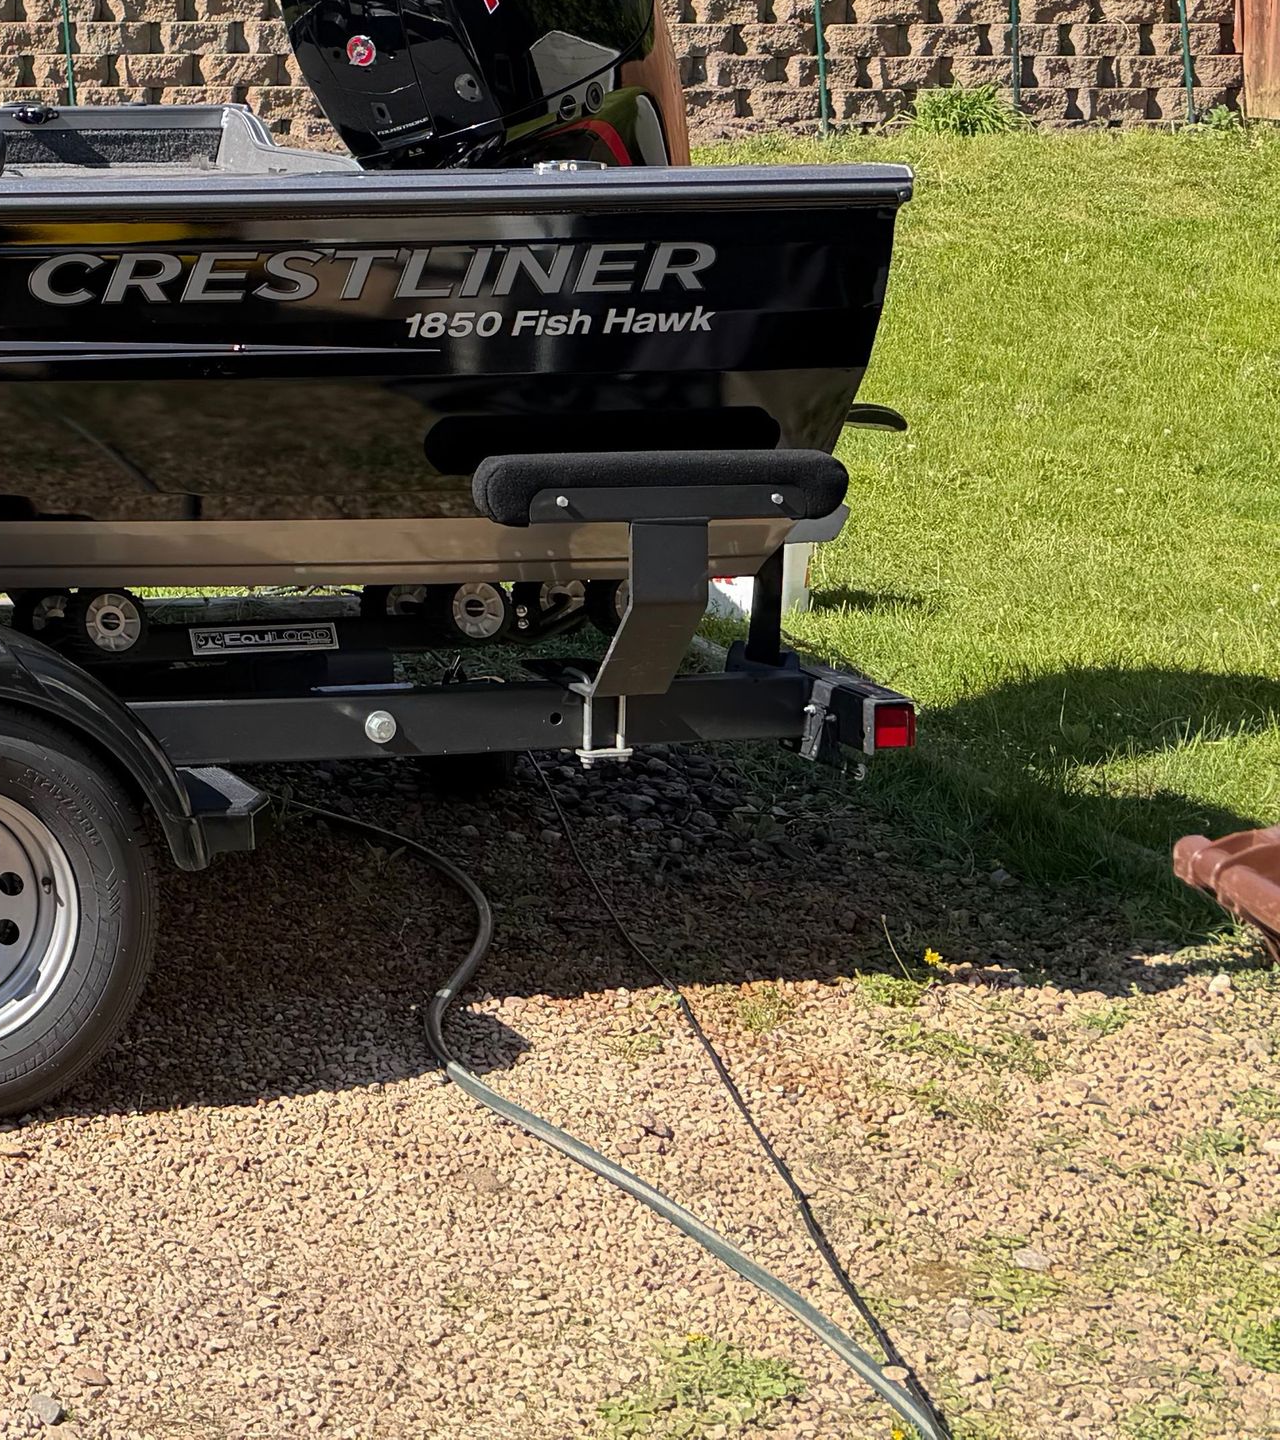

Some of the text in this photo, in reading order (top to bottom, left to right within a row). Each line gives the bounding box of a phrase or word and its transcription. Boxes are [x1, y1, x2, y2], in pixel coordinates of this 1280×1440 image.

[27, 241, 717, 305] CRESTLINER
[405, 306, 717, 338] 1850 Fish Hawk
